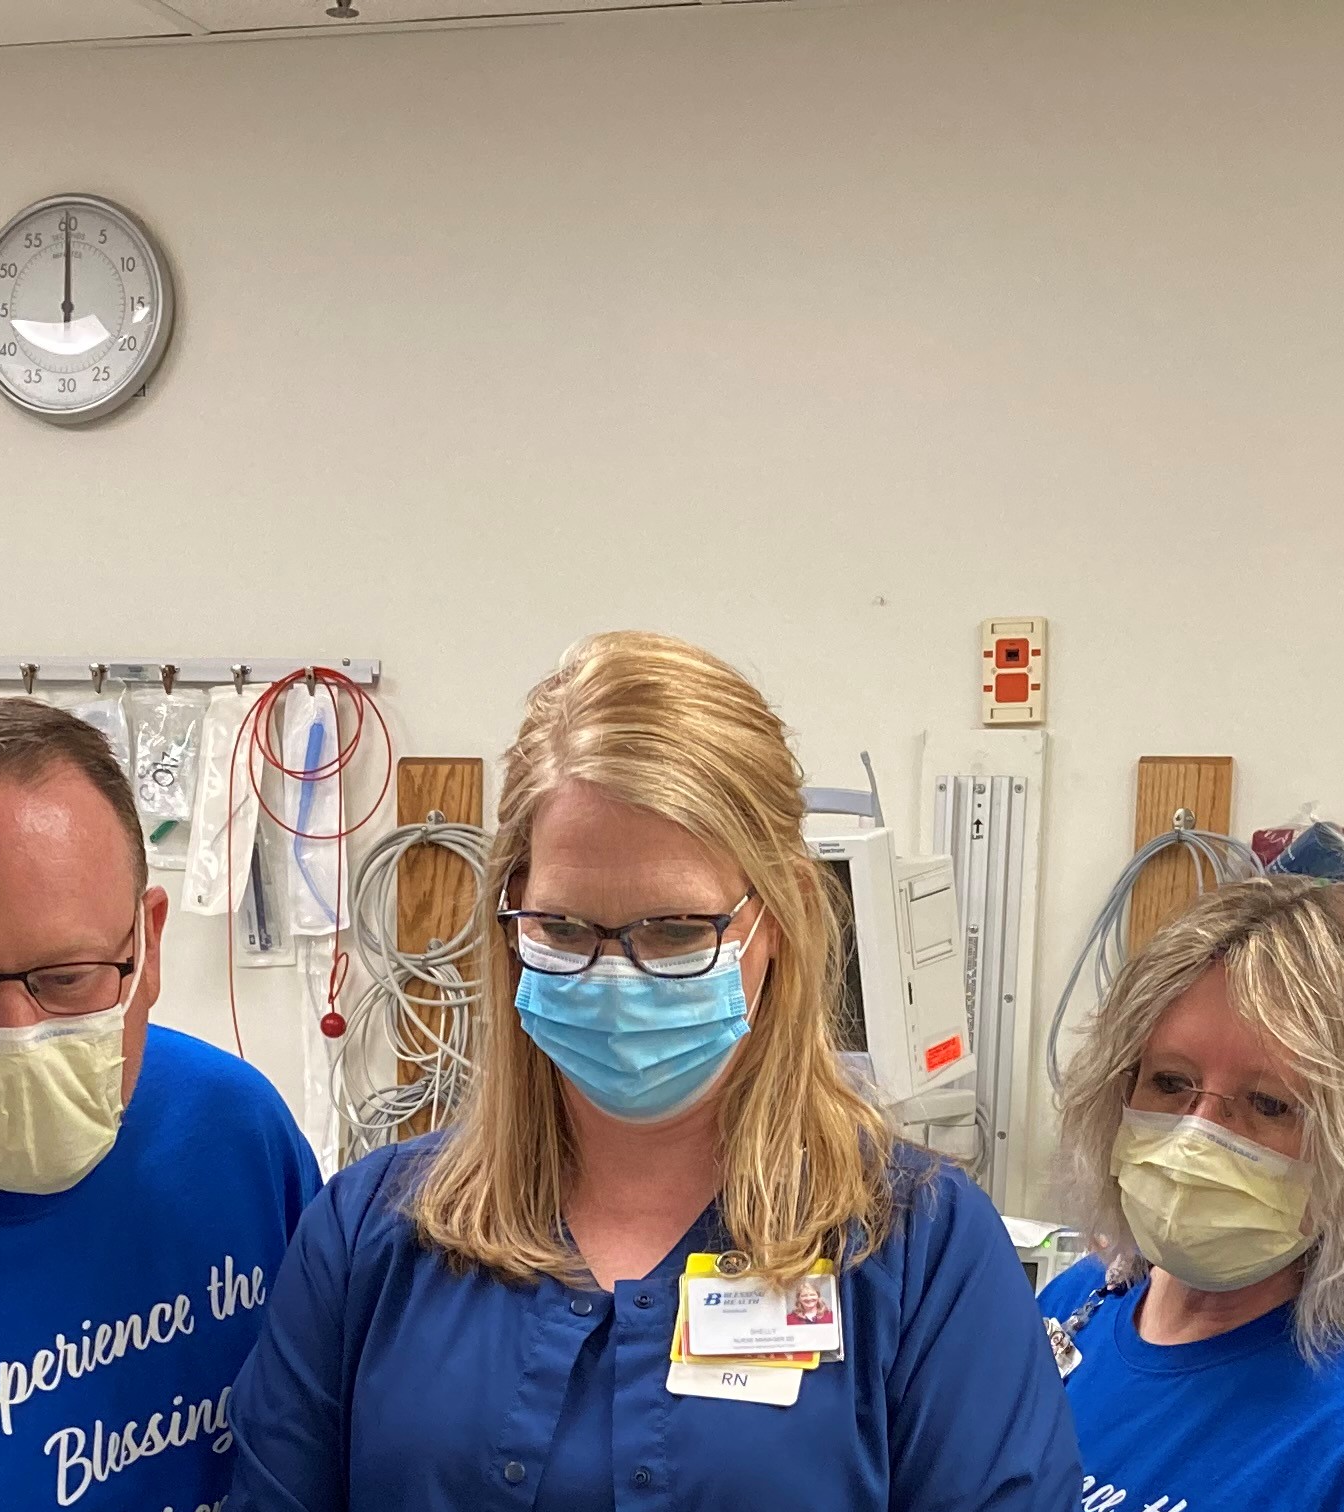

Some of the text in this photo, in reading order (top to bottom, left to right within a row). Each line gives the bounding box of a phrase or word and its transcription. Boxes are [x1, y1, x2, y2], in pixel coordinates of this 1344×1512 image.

[58, 216, 78, 232] 60
[24, 233, 43, 248] 55
[98, 229, 108, 244] 5
[0, 263, 17, 278] 50
[120, 257, 136, 272] 10
[130, 296, 145, 312] 15
[0, 342, 17, 357] 40
[119, 336, 137, 351] 20
[24, 369, 42, 384] 35
[92, 366, 110, 382] 25
[57, 378, 77, 393] 30
[206, 1254, 267, 1321] the
[721, 1372, 748, 1387] RN
